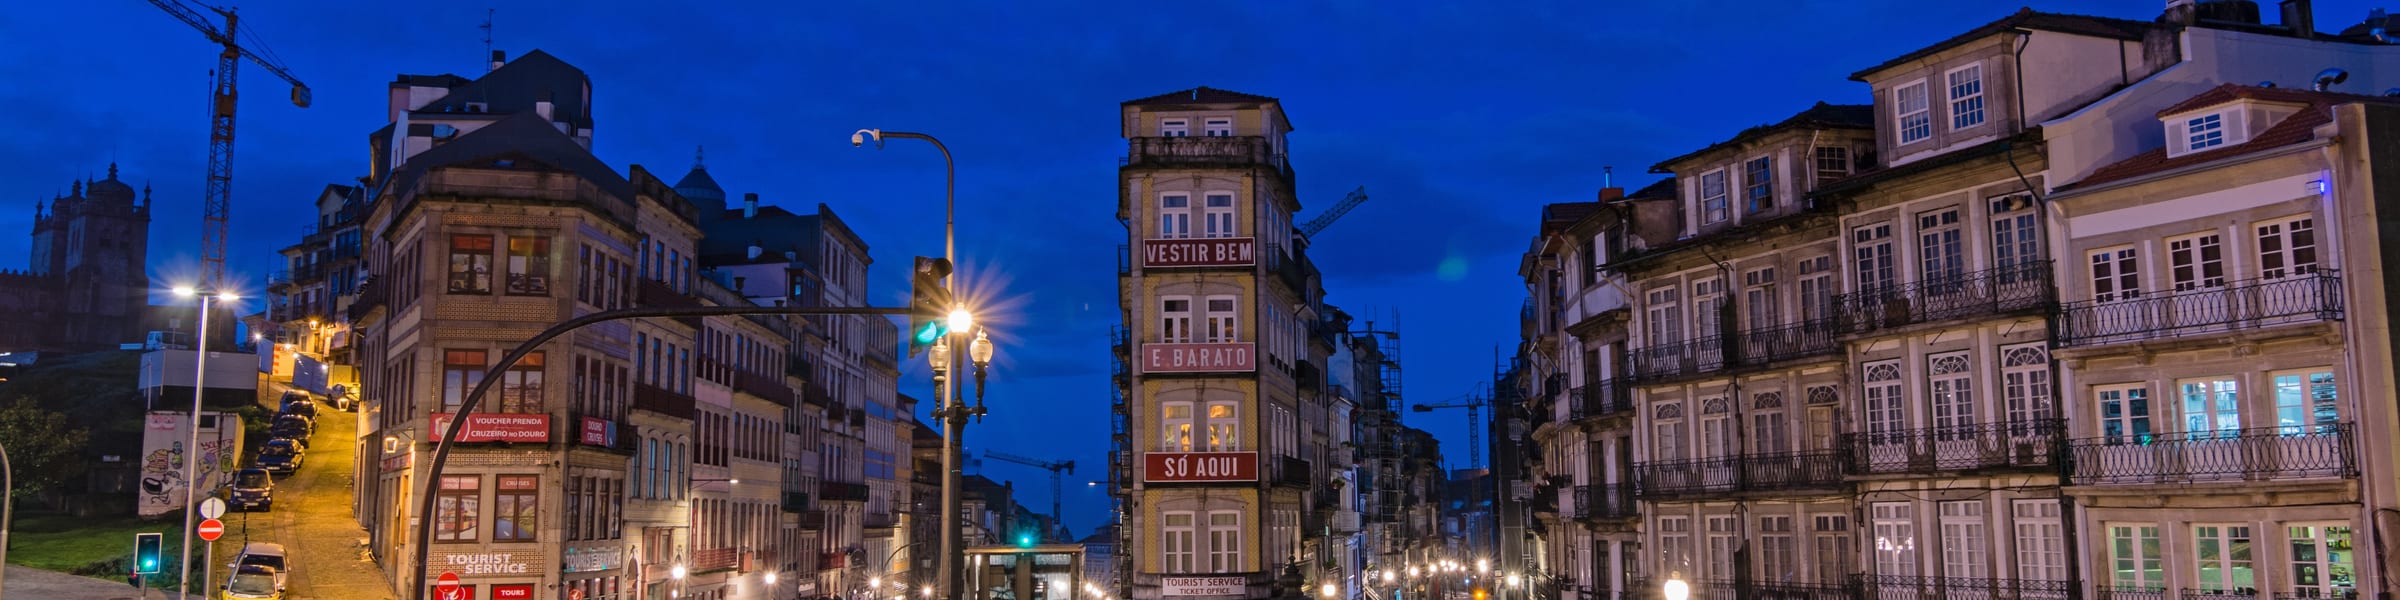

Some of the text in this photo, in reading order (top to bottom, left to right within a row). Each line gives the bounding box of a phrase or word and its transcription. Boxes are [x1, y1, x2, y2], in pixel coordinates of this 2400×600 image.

[1146, 242, 1252, 263] VESTIR BEM
[1152, 347, 1246, 368] E BARATO
[475, 417, 542, 425] VOUCHER PRENDA
[470, 430, 508, 438] CRUZEIRO
[518, 430, 546, 438] DOURO
[1164, 454, 1238, 477] SÓ AQUI
[447, 553, 512, 565] TOURIST
[464, 563, 527, 574] SERVICE
[1166, 577, 1243, 587] TOURIST SERVICE
